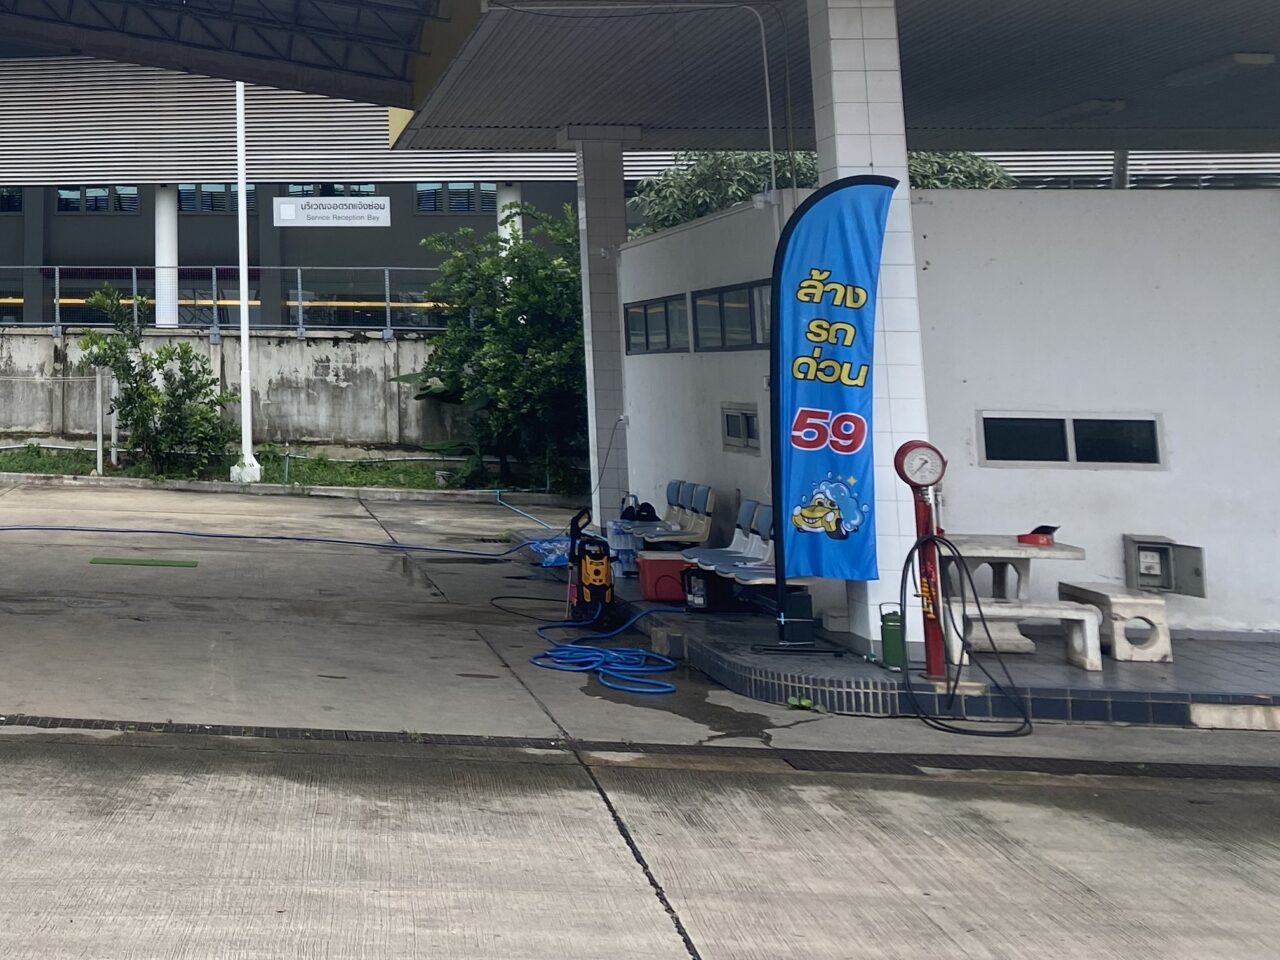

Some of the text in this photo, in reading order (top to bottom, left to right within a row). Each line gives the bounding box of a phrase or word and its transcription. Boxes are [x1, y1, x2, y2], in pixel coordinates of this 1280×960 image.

[332, 214, 365, 222] Reception
[367, 214, 380, 222] Bay
[796, 268, 868, 309] ล้าง
[805, 319, 856, 347] รถ
[791, 347, 869, 388] ด่วน
[791, 406, 868, 456] 59
